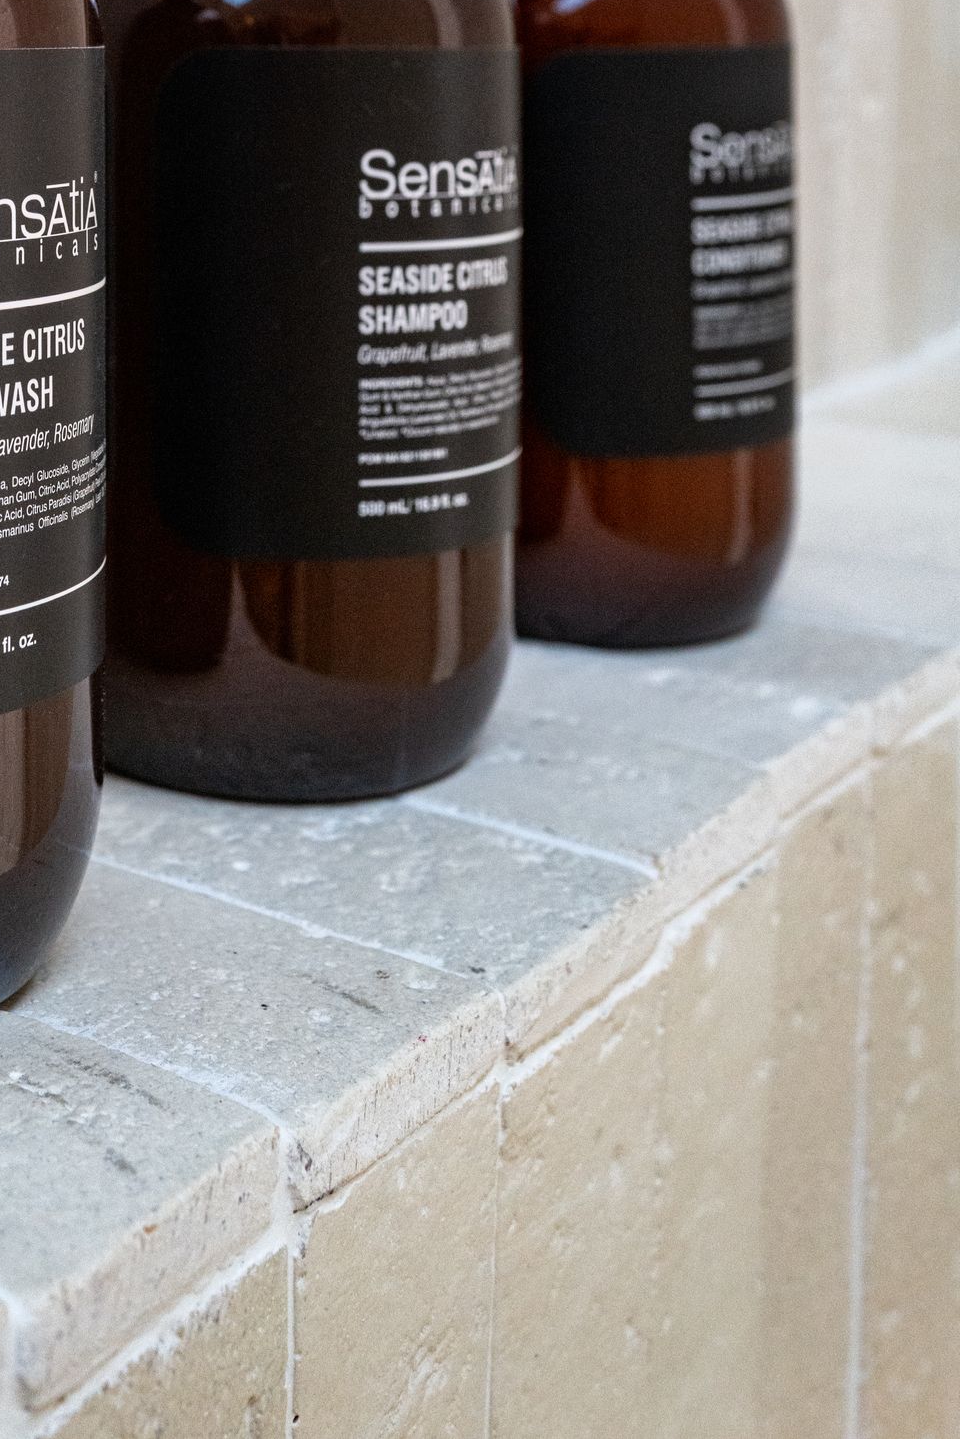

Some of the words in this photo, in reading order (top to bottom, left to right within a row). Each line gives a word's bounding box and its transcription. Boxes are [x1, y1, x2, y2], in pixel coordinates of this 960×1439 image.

[358, 262, 454, 296] SEASIDE
[358, 299, 468, 335] SHAMPOO
[22, 318, 85, 363] CITRUS
[53, 414, 95, 444] Rosemary
[11, 472, 34, 488] Decyl
[36, 464, 70, 482] Glucoside,
[3, 507, 24, 522] Acid,
[26, 503, 47, 516] Citrus
[48, 493, 72, 510] Paradisi
[16, 490, 37, 503] Gum,
[38, 483, 56, 497] Citric
[38, 511, 69, 529] Officinalis
[2, 636, 15, 653] fl.
[18, 633, 37, 649] oz.
